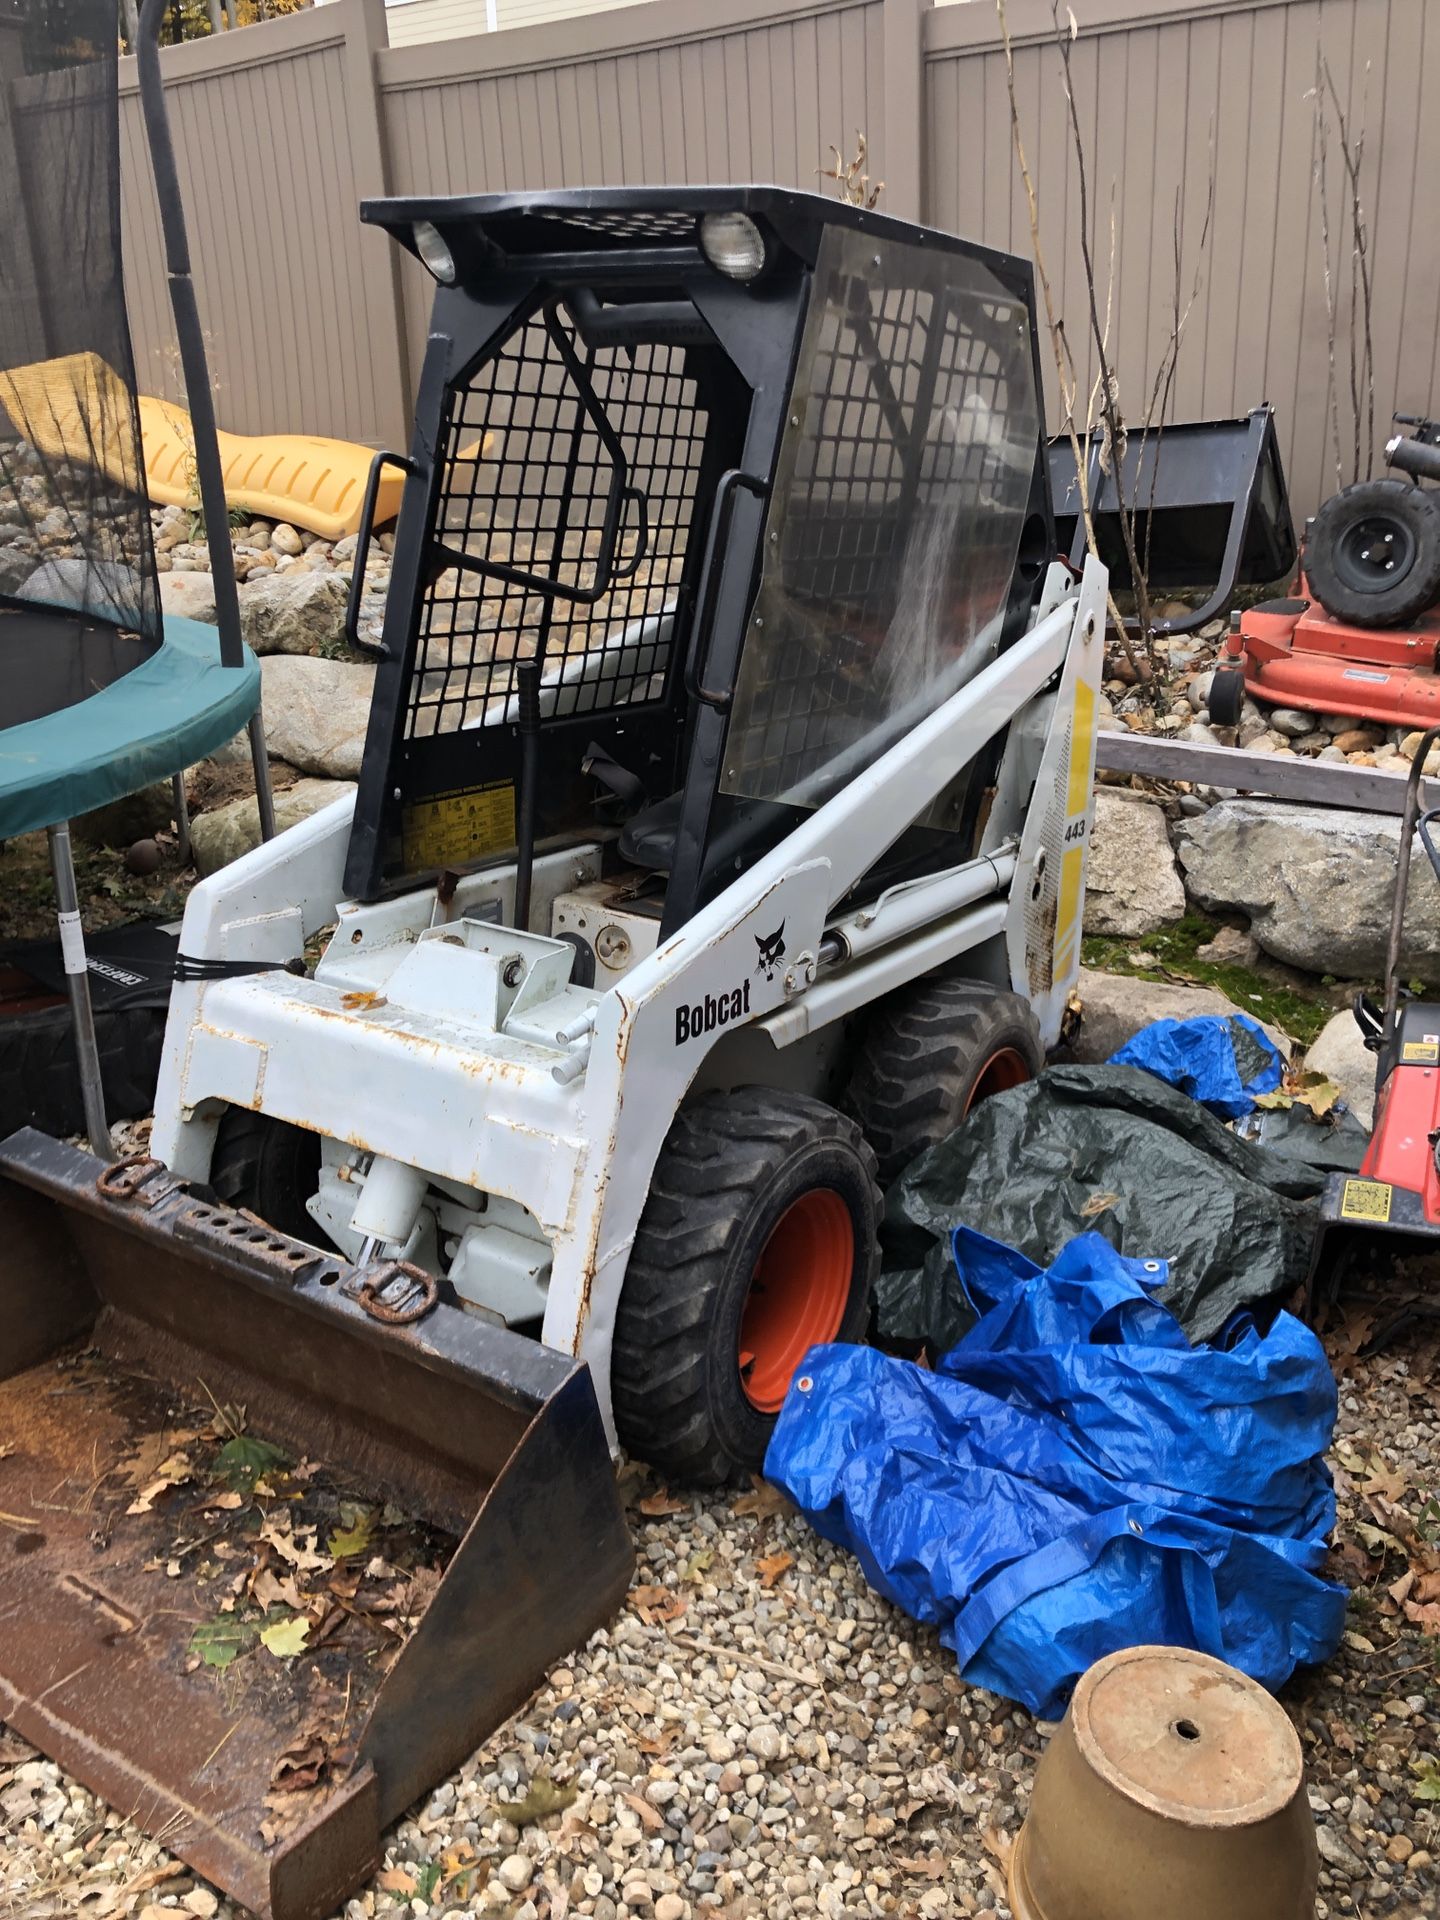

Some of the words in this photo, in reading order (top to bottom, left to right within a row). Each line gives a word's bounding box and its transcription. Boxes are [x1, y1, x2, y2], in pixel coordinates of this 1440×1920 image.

[1065, 820, 1086, 843] 443
[86, 957, 142, 986] CRAFTSM
[675, 978, 750, 1046] Bobcat
